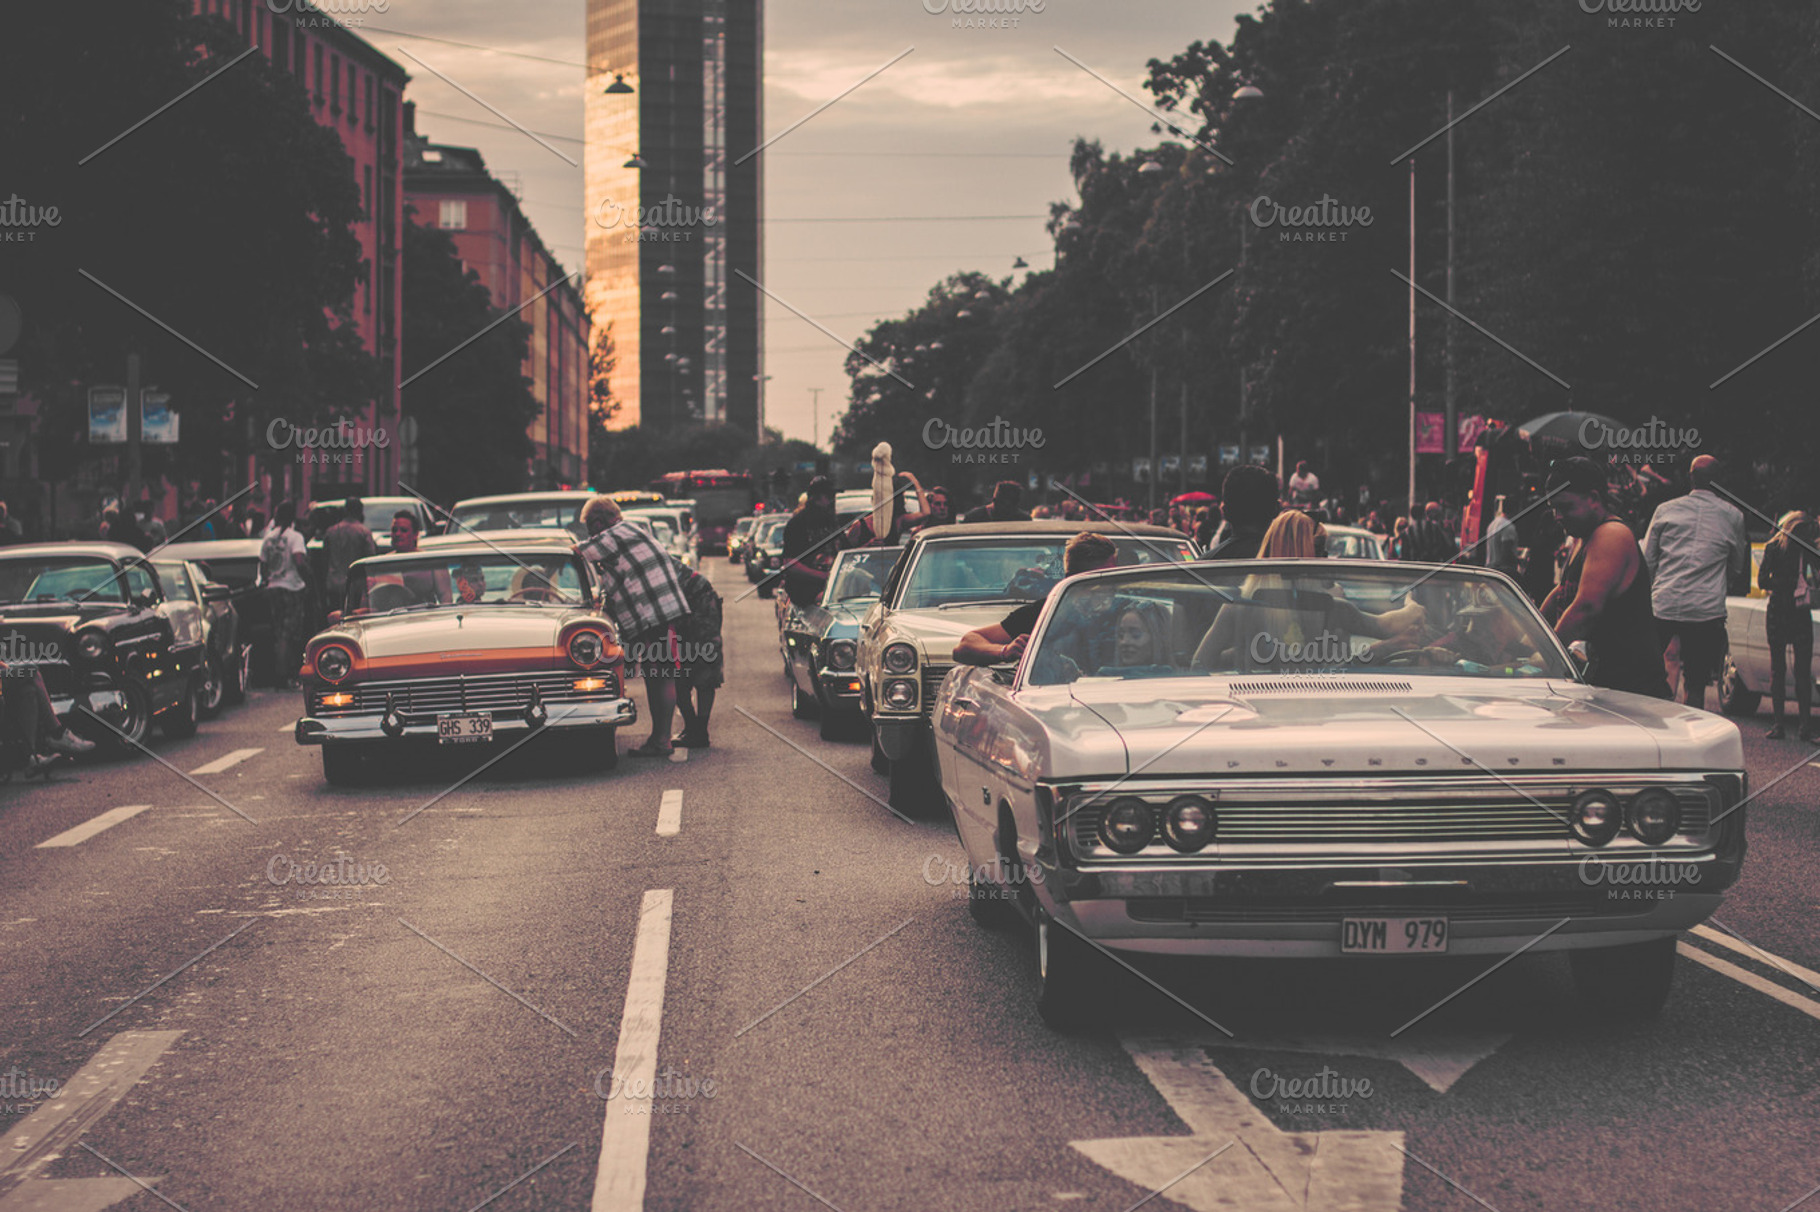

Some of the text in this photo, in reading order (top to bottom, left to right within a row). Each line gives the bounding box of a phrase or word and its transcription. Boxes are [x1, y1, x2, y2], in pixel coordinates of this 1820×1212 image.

[440, 719, 490, 735] GHS 339
[1344, 920, 1446, 949] DYM 979
